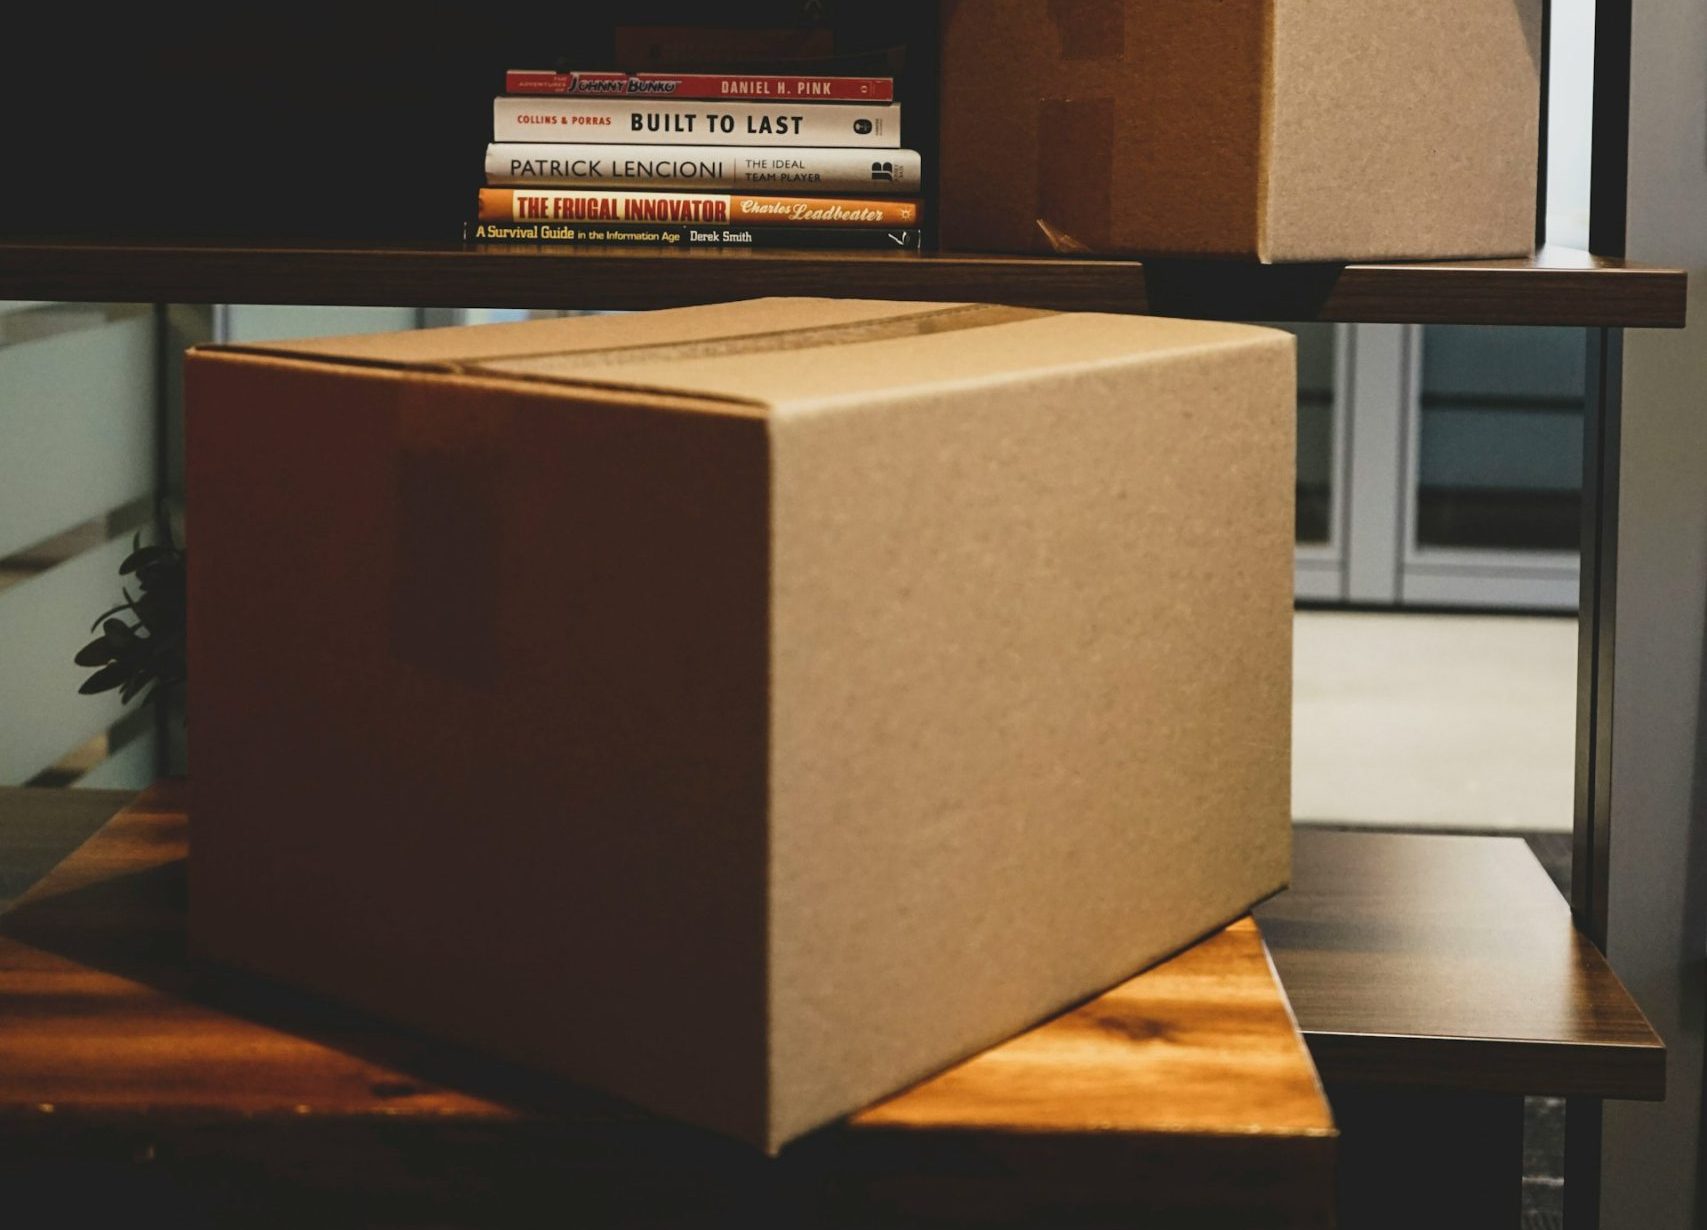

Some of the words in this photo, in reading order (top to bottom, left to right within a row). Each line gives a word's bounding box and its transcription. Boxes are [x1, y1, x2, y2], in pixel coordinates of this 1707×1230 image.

[568, 74, 626, 92] JOHNNY
[627, 77, 677, 94] BUNKO
[721, 81, 770, 94] DANIEL
[777, 82, 791, 94] H.
[797, 82, 831, 95] PINK
[517, 114, 557, 125] COLLINS
[561, 116, 568, 125] &
[572, 116, 611, 126] PORRAS
[631, 113, 697, 132] BUILT
[706, 114, 735, 134] TO
[747, 116, 804, 135] LAST
[510, 159, 602, 177] PATRICK
[612, 160, 722, 179] LENCIONI
[745, 159, 768, 169] THE
[772, 159, 805, 169] IDEAL
[745, 173, 777, 183] TEAM
[781, 173, 821, 184] PLAYER
[517, 196, 549, 219] THE
[553, 197, 620, 221] FRUGAL
[624, 198, 728, 223] INNOVATOR
[739, 199, 791, 214] Charles
[789, 203, 884, 222] Leadbeater
[476, 225, 486, 238] A
[487, 225, 538, 240] Survival
[541, 225, 575, 240] Guide
[578, 231, 586, 240] in
[589, 231, 605, 240] the
[606, 231, 660, 242] Information
[662, 232, 680, 243] Age
[690, 231, 720, 242] Derek
[722, 231, 752, 242] Smith
